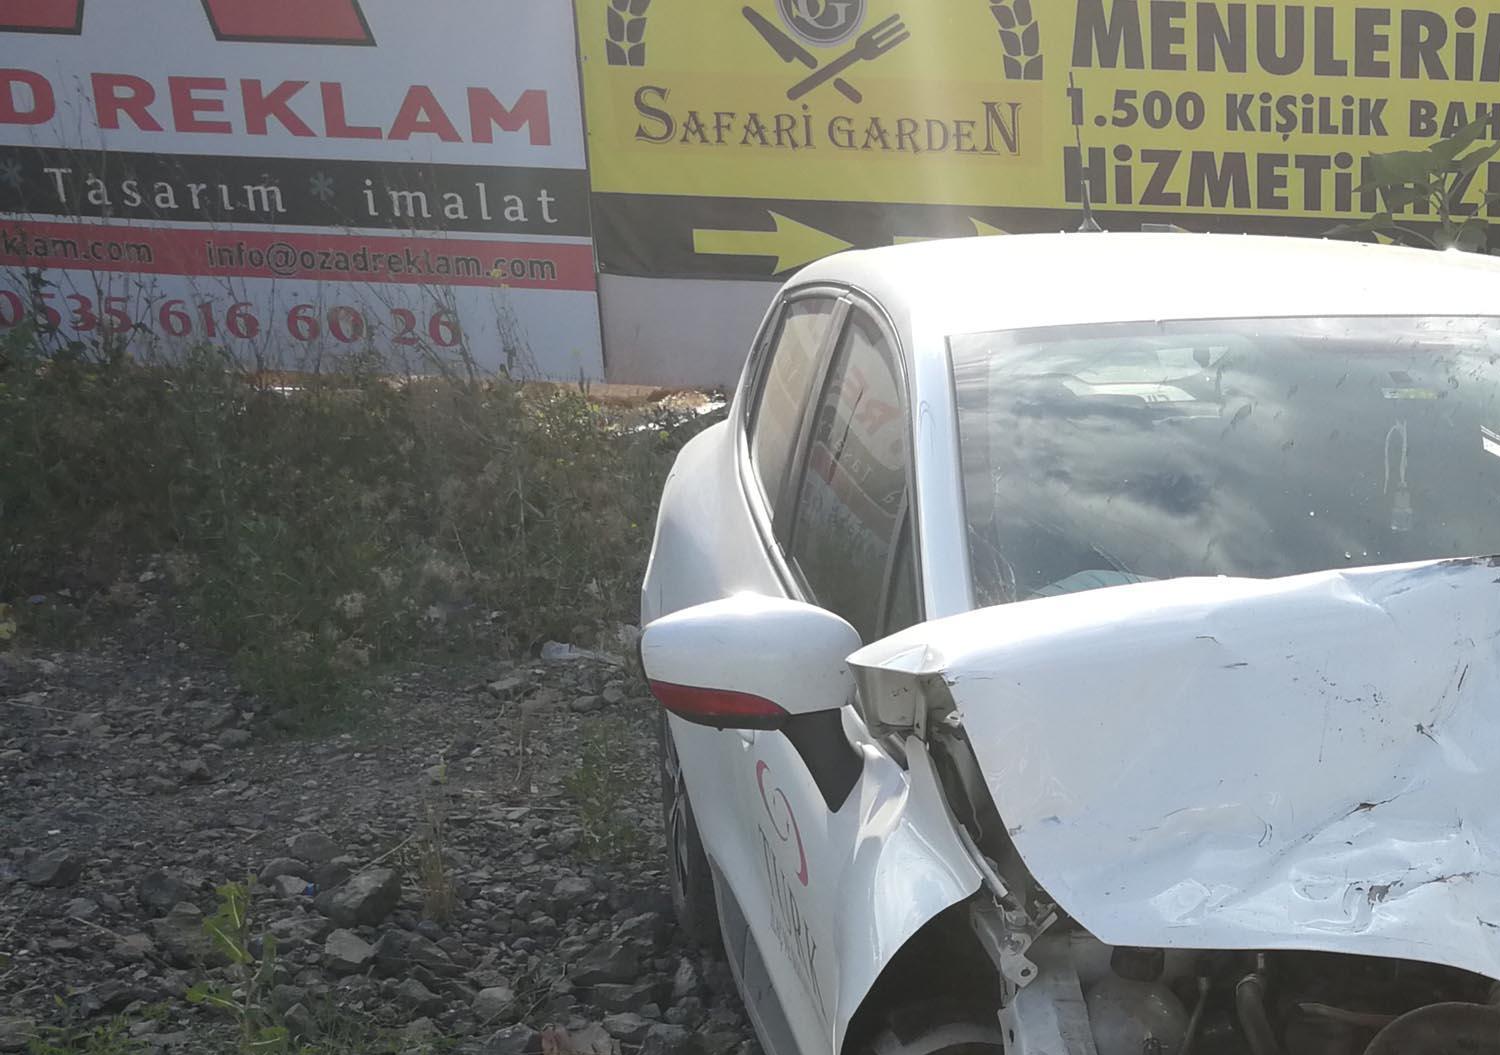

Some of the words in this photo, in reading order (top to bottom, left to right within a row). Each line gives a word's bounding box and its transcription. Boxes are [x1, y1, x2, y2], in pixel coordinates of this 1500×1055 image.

[90, 72, 552, 146] REKLAM
[828, 101, 1022, 156] GARDEN
[1066, 87, 1205, 130] 1.500
[43, 167, 287, 213] Tasarım
[363, 178, 558, 223] imalat
[205, 240, 558, 281] info@ozadreklam.com
[159, 299, 260, 340] 616
[287, 303, 368, 344] 60
[390, 307, 463, 348] 26
